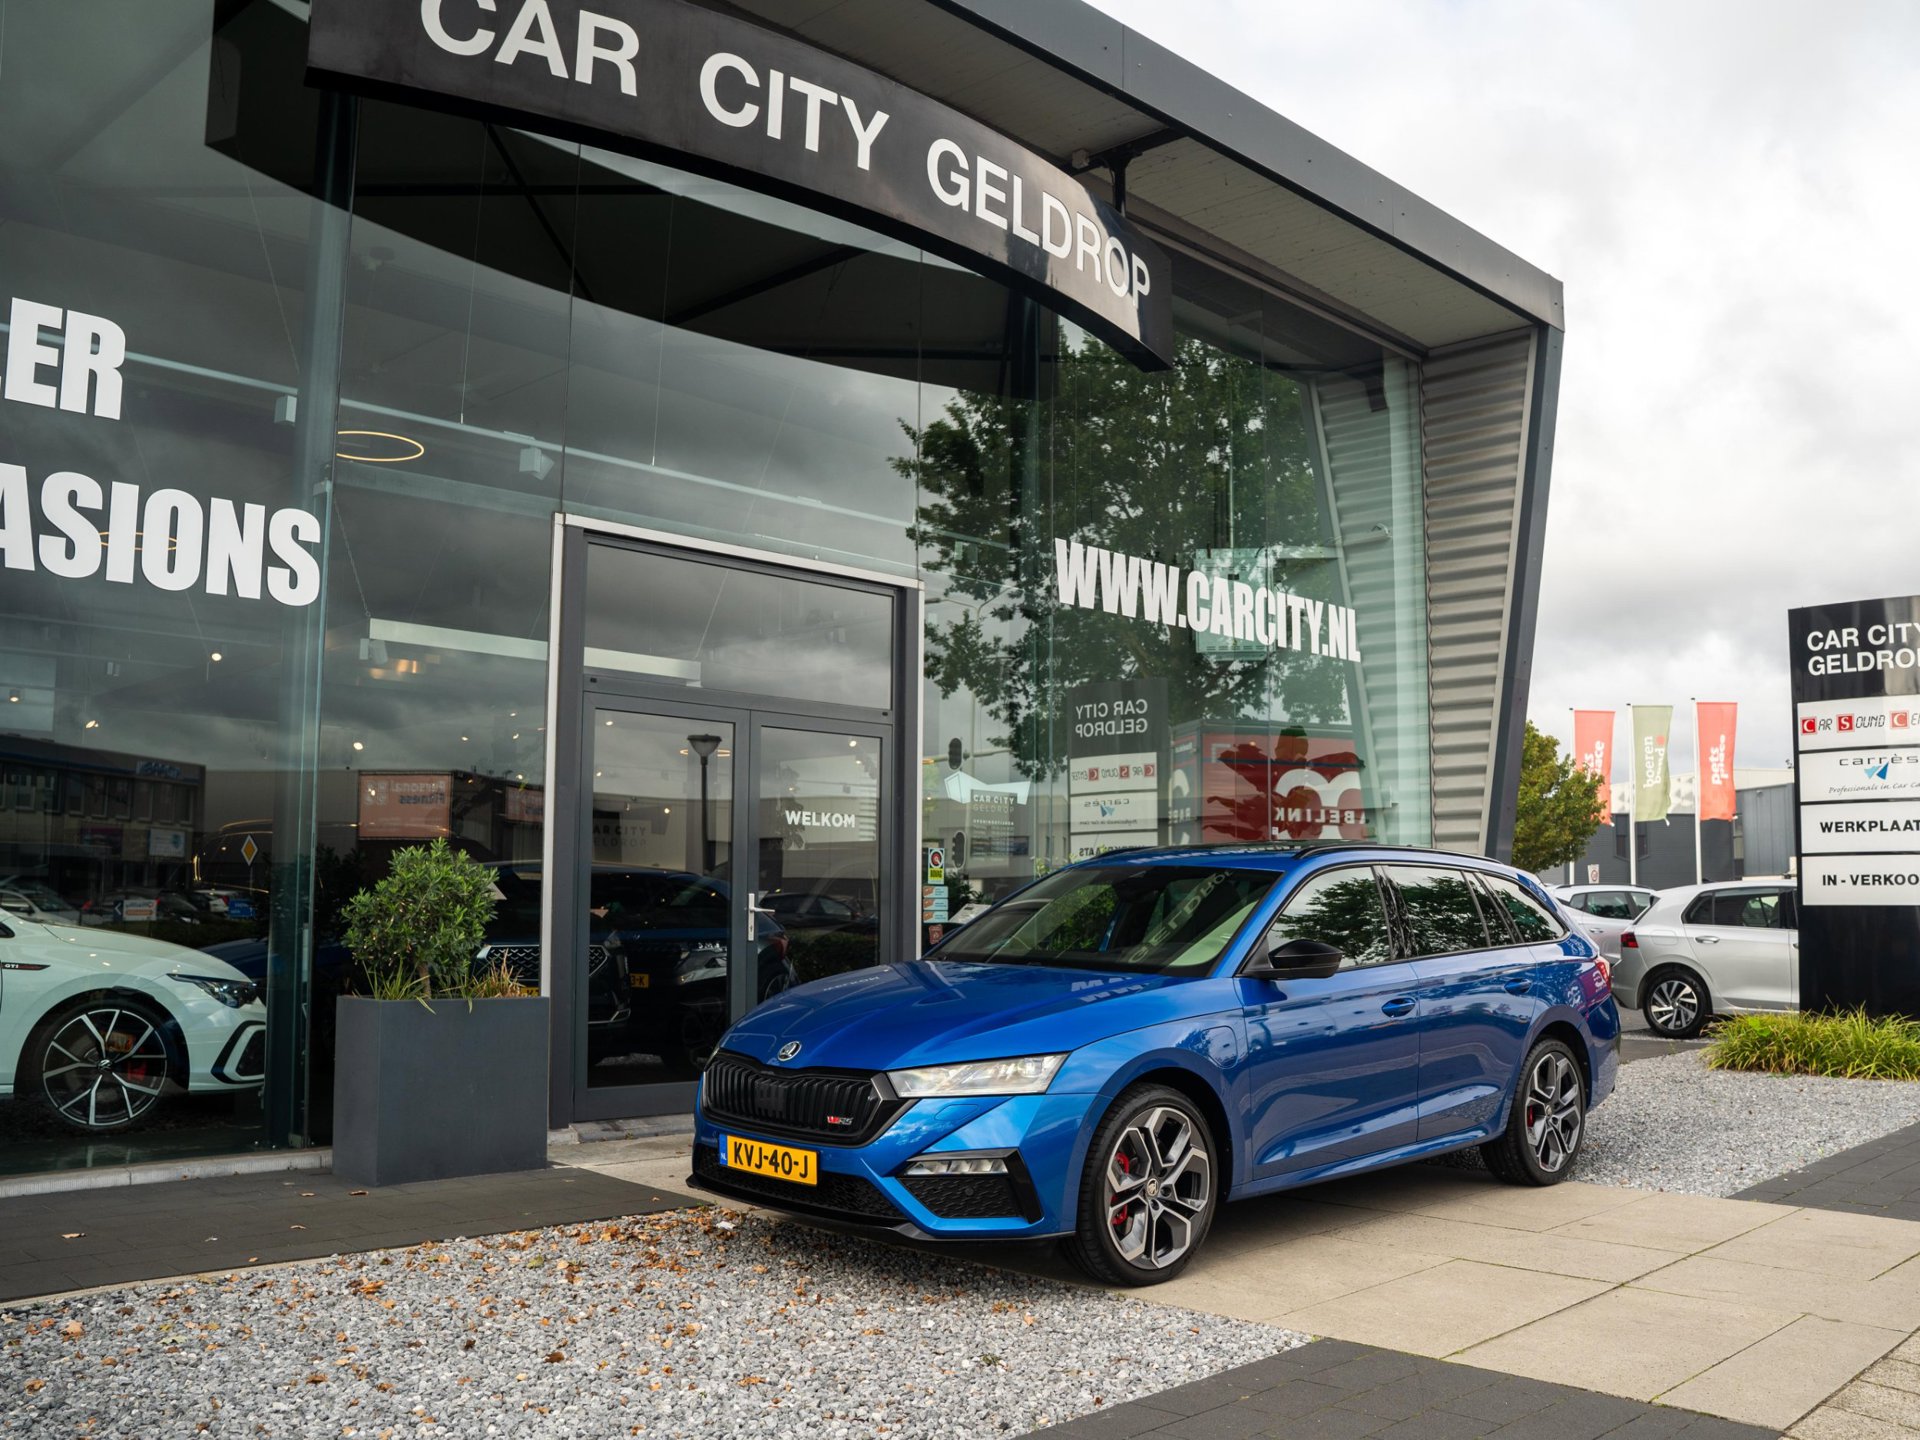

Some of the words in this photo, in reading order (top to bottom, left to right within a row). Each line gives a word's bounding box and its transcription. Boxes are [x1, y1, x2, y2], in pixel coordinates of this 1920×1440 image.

[421, 0, 637, 96] CAR
[700, 52, 890, 171] CITY
[927, 138, 1150, 309] GELDROP
[0, 297, 126, 420] ER
[1055, 537, 1361, 662] WWW.CARCITY.NL
[1807, 627, 1859, 651] CAR
[1808, 647, 1920, 676] GELDRO
[1838, 714, 1885, 731] SOUND
[1891, 711, 1920, 728] CE
[1643, 735, 1654, 789] boeren
[1709, 746, 1722, 785] pets
[1839, 753, 1919, 766] carrès
[785, 810, 855, 828] WELKOM
[1822, 874, 1837, 886] IN
[1850, 873, 1920, 886] VERKOO
[720, 1152, 727, 1161] NL
[733, 1141, 809, 1179] KVJ-40-J
